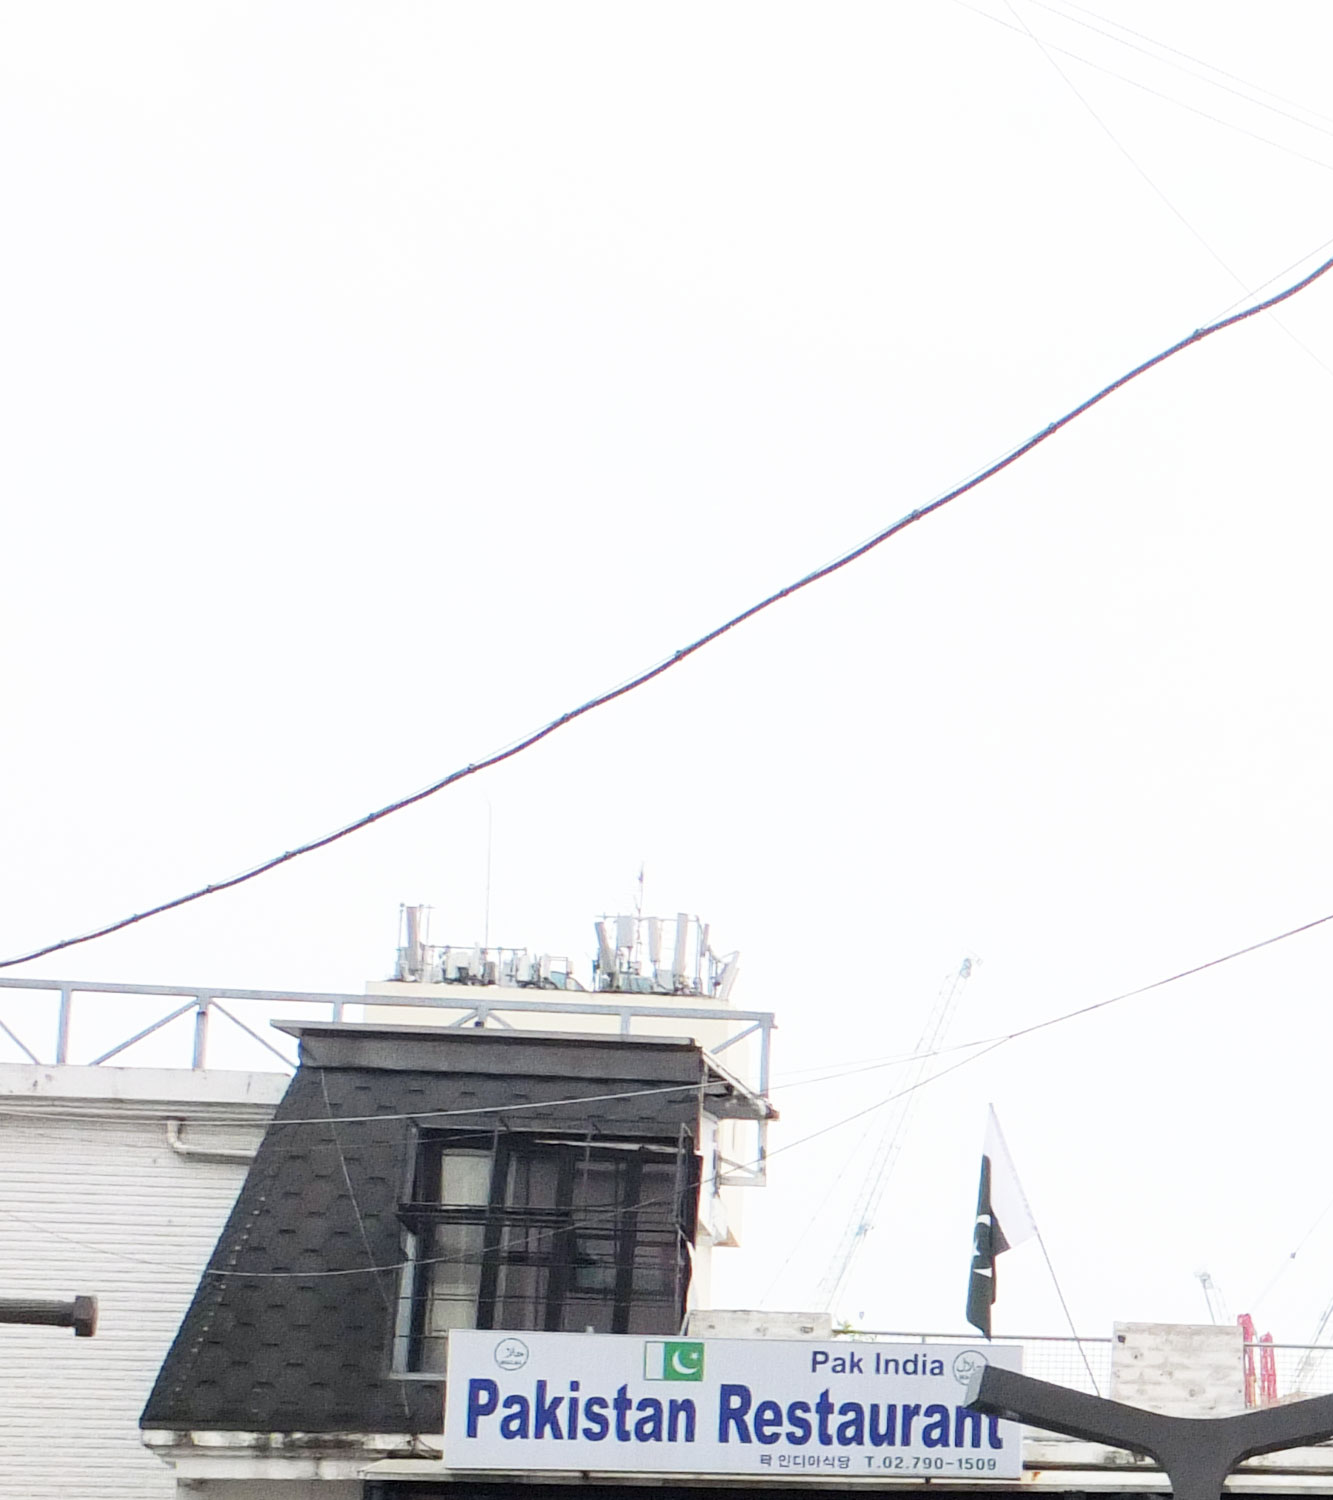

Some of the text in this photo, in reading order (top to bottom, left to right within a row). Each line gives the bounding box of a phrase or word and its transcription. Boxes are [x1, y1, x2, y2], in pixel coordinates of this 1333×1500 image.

[811, 1350, 945, 1376] Pak India
[466, 1379, 1004, 1450] Pakistan Restaurant
[864, 1456, 997, 1471] T.02.790-1509
